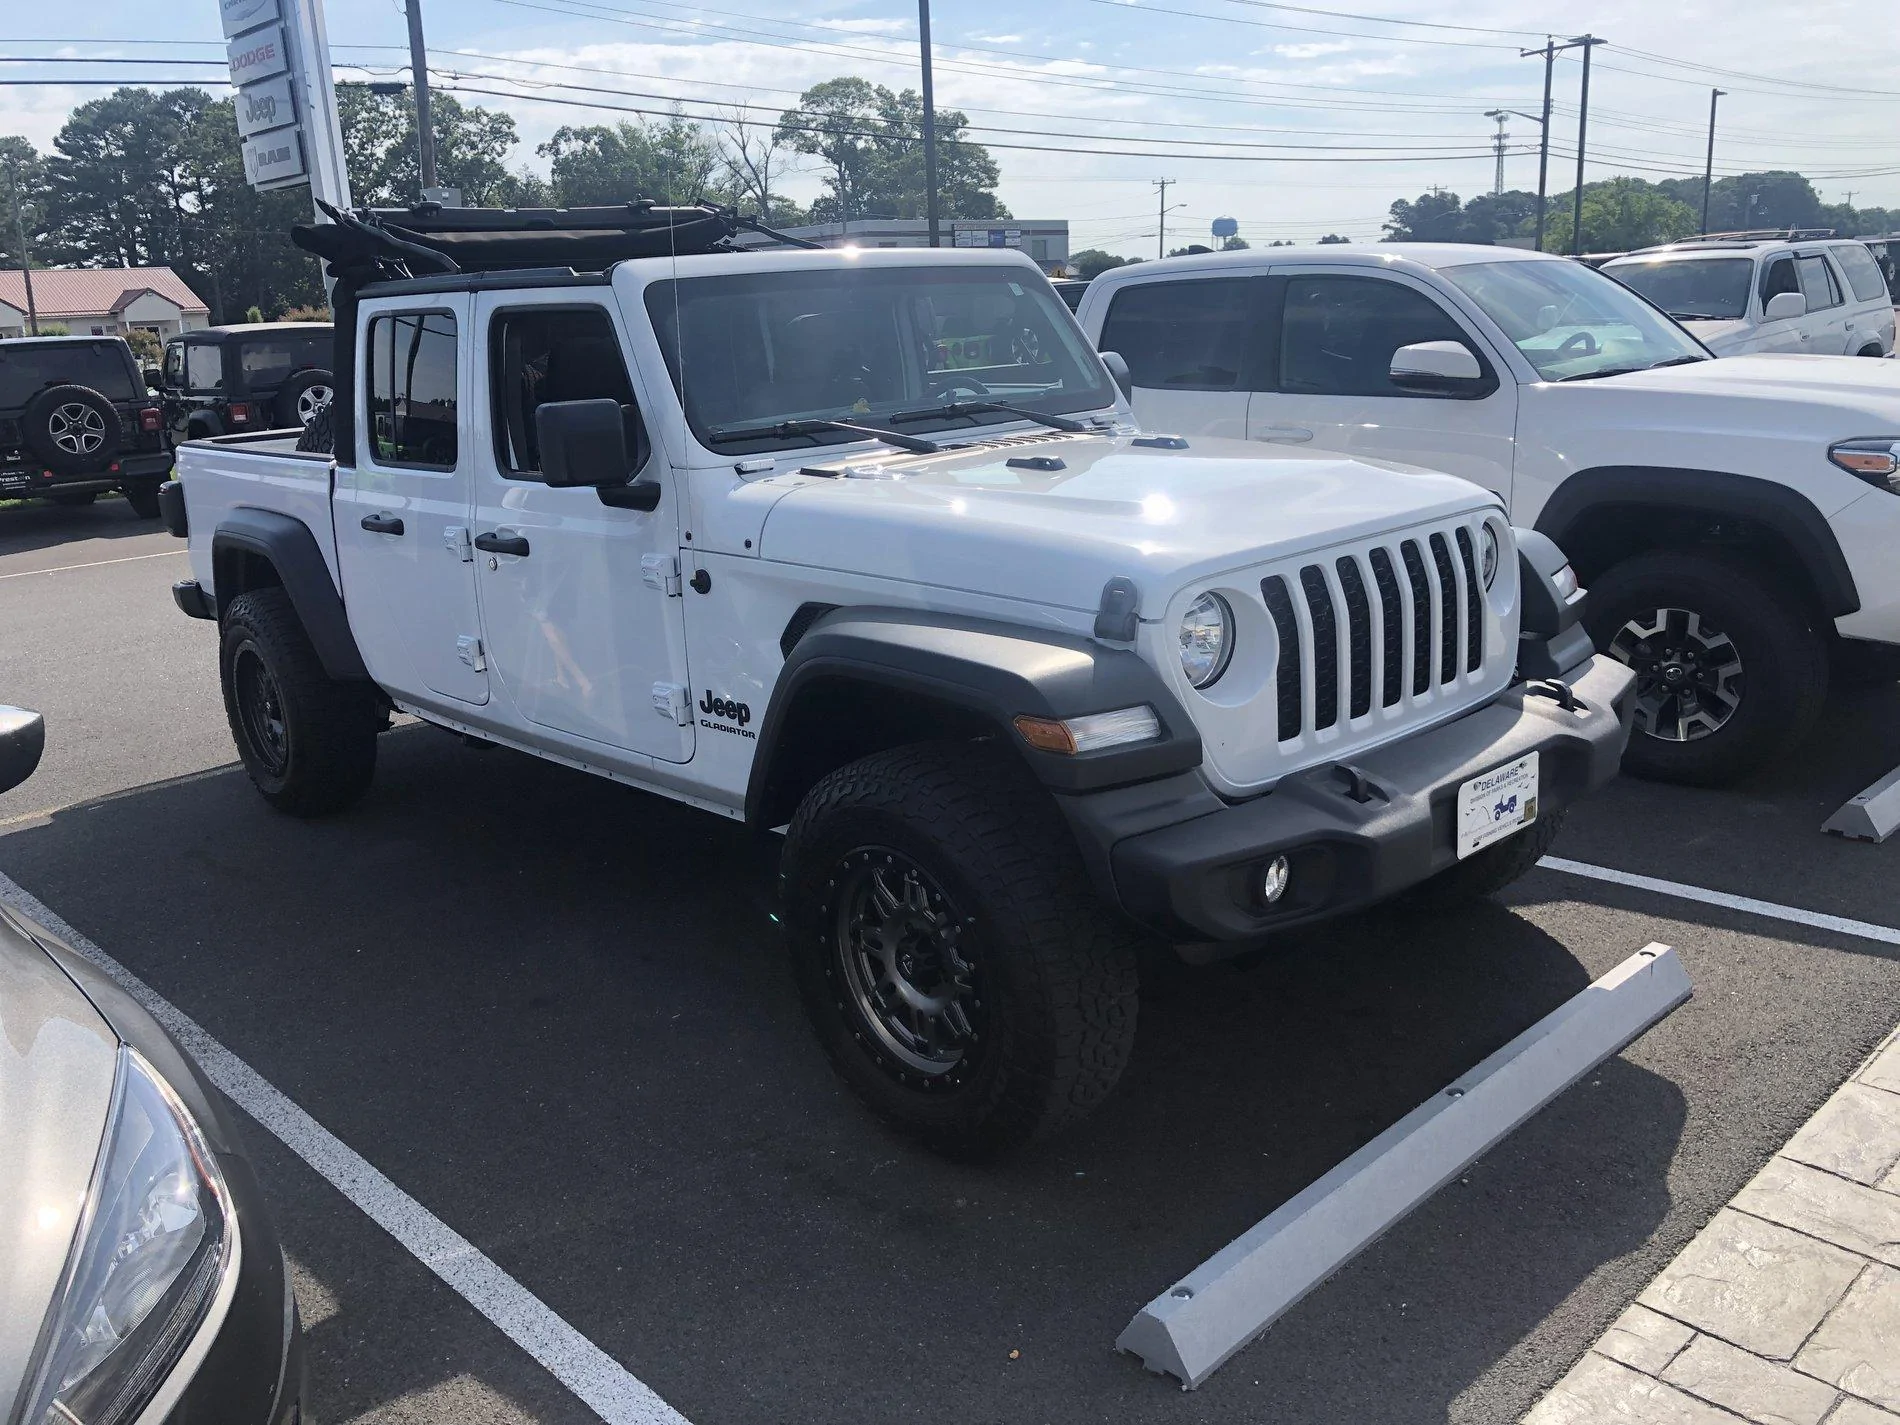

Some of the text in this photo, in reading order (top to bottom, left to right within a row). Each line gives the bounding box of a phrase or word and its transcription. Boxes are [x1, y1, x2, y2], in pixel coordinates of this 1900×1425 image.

[231, 44, 275, 71] DODGE
[246, 94, 276, 124] Jeep
[257, 146, 291, 166] RAM
[700, 690, 750, 726] Jeep
[700, 719, 756, 739] GLADIATOR
[1482, 766, 1519, 791] DELAWARE
